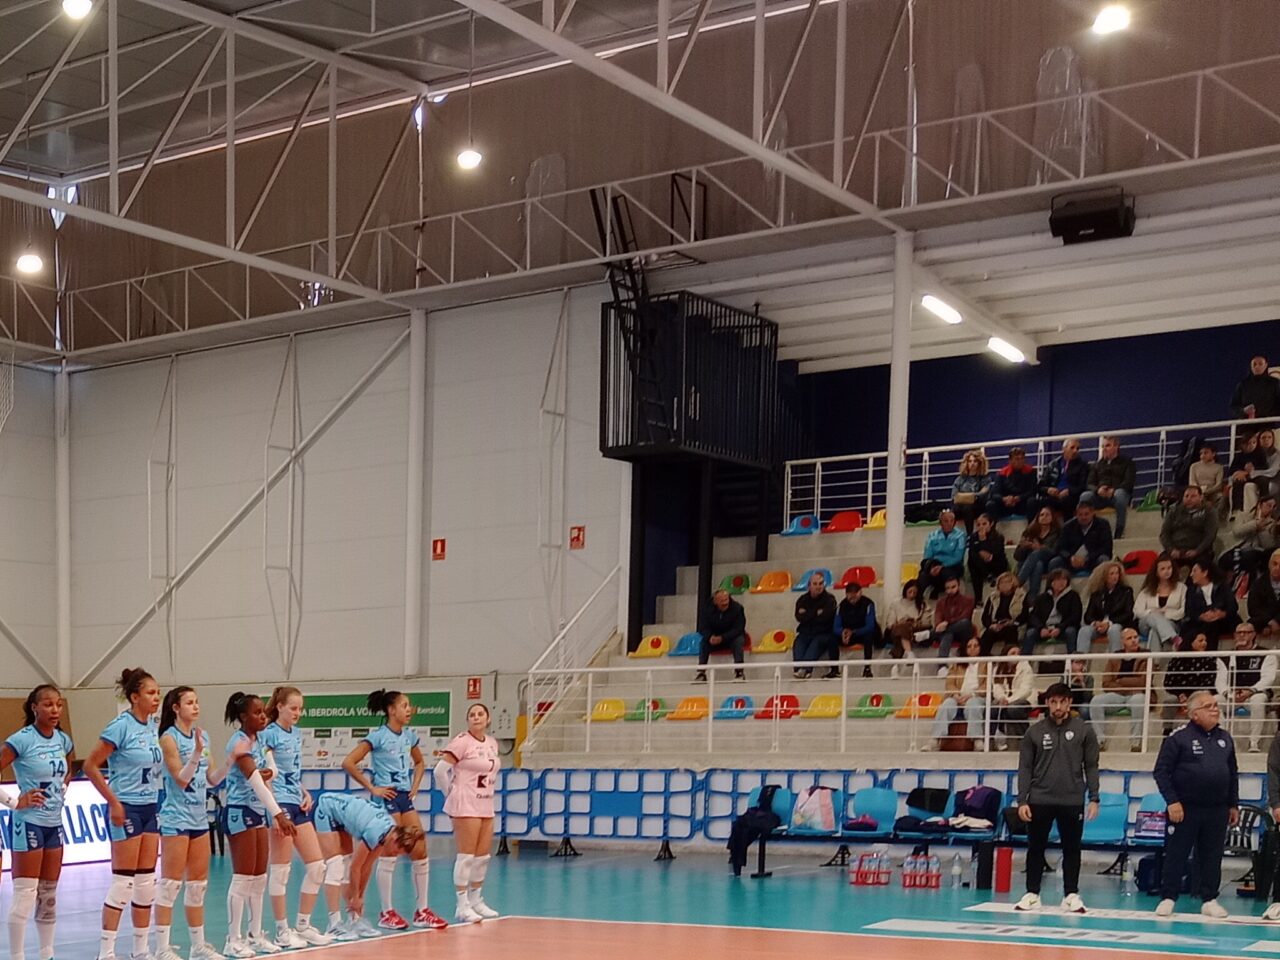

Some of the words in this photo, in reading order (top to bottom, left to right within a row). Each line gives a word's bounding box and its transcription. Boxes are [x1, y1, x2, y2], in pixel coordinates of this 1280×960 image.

[149, 747, 162, 764] 10
[399, 754, 406, 770] 1
[49, 760, 66, 778] 14
[488, 759, 495, 773] 7
[64, 804, 94, 845] LA
